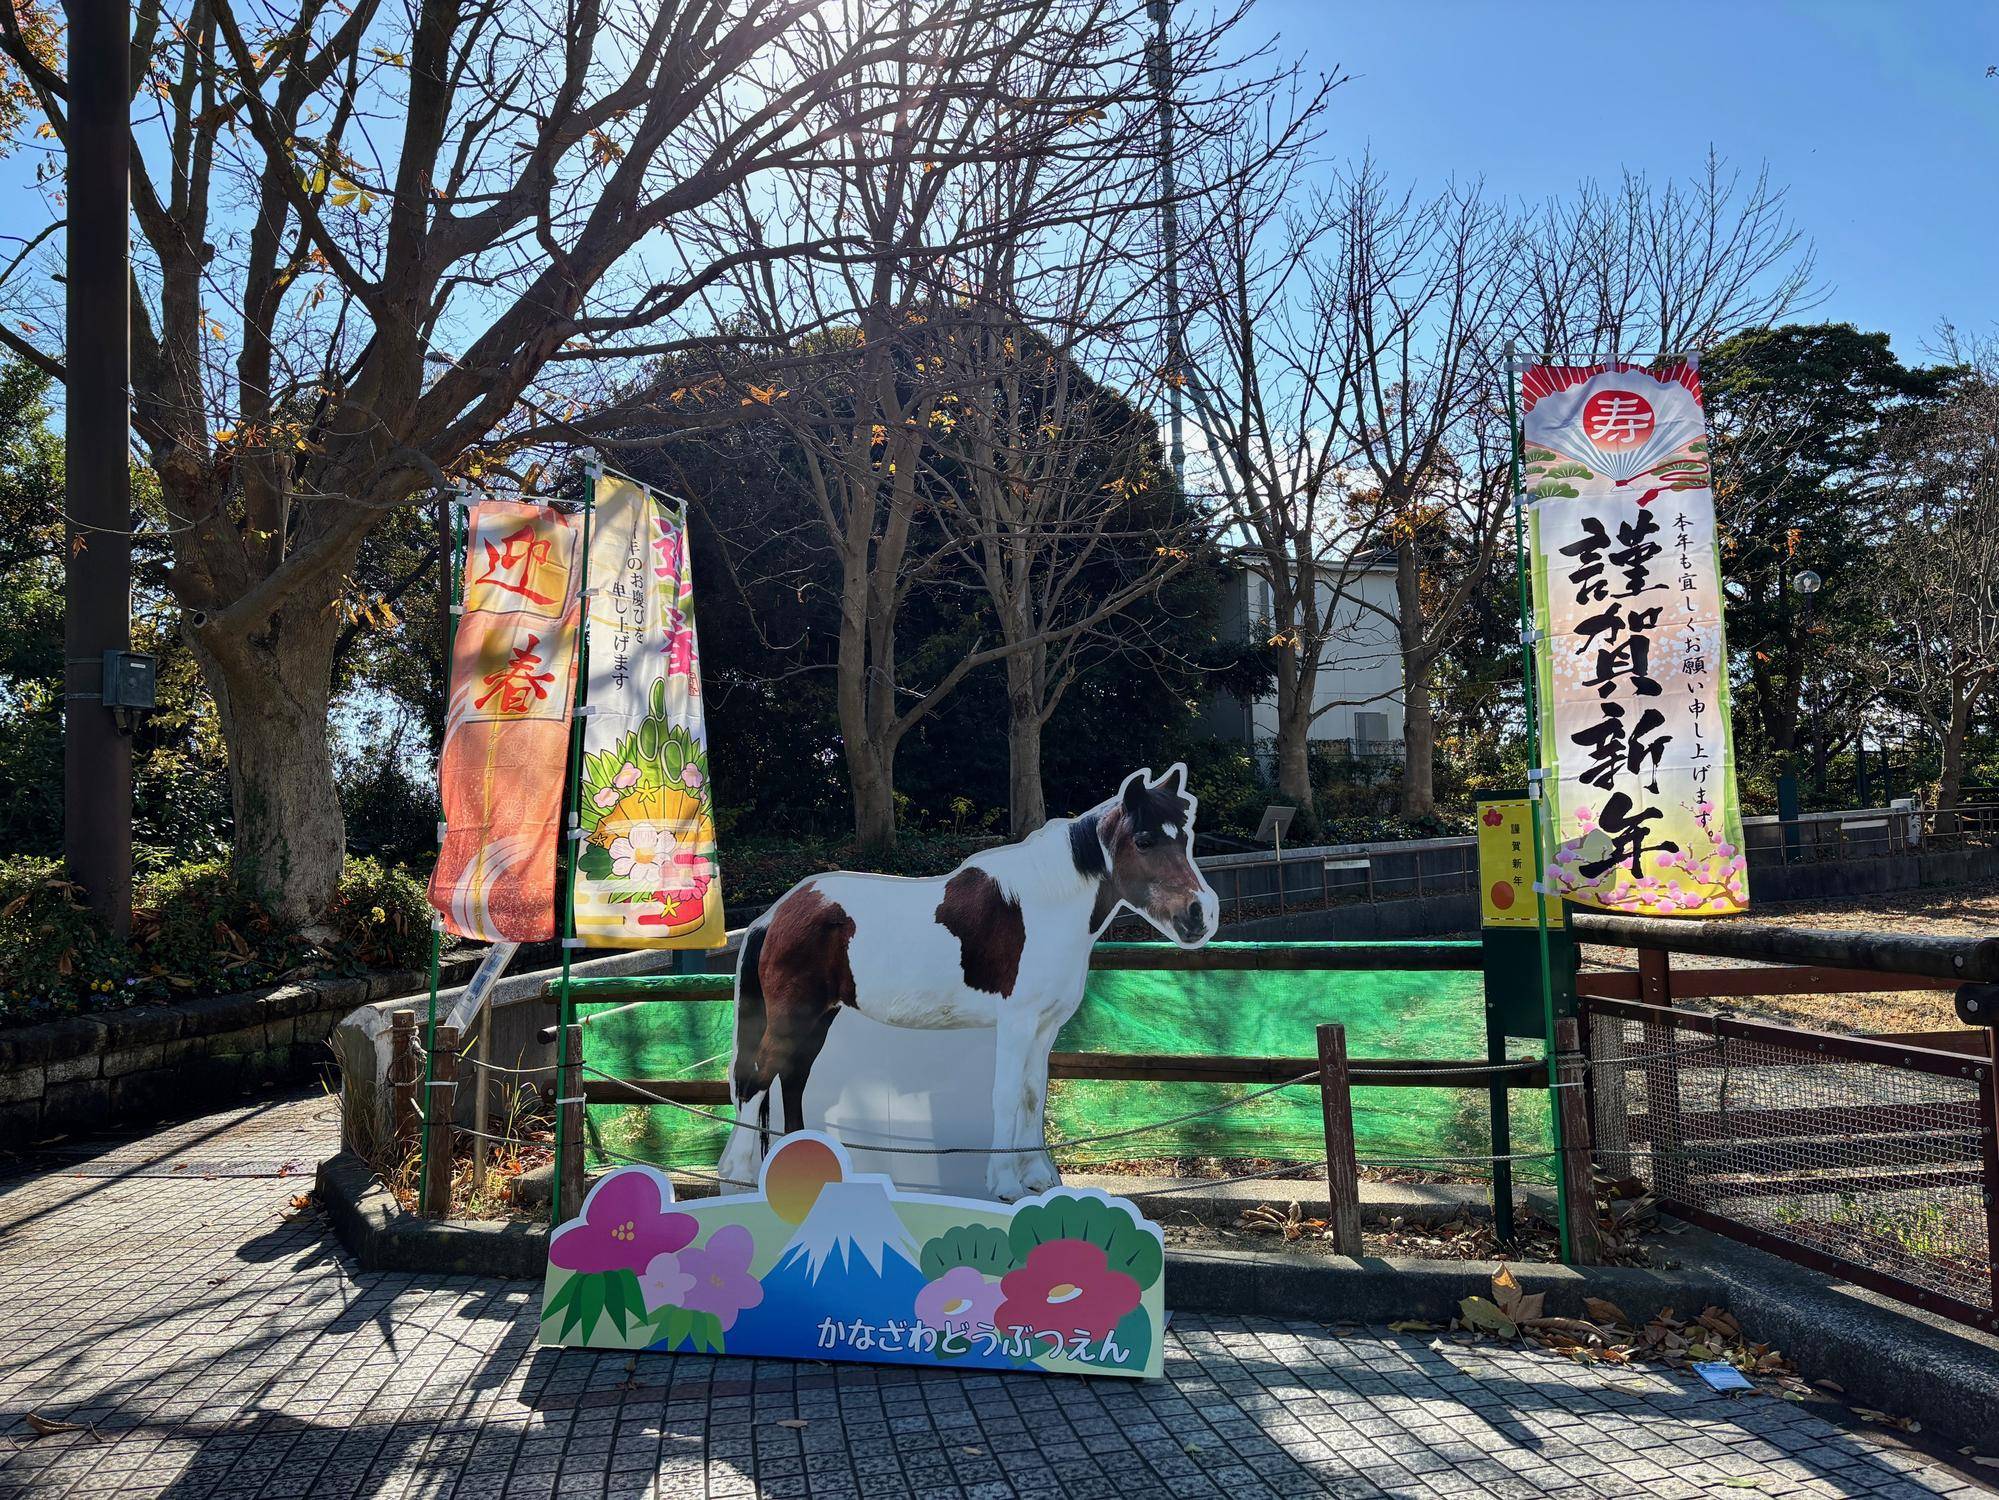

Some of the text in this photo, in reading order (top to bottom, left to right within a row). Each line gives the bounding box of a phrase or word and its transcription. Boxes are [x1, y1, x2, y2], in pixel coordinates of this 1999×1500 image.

[1591, 397, 1653, 443] 寿
[474, 524, 560, 713] 迎春
[1559, 509, 1679, 879] 謹賀新年
[1672, 513, 1714, 837] 本年も宜しくお願い申し上げます。
[816, 1315, 1130, 1364] かなざわどうぶつえん
